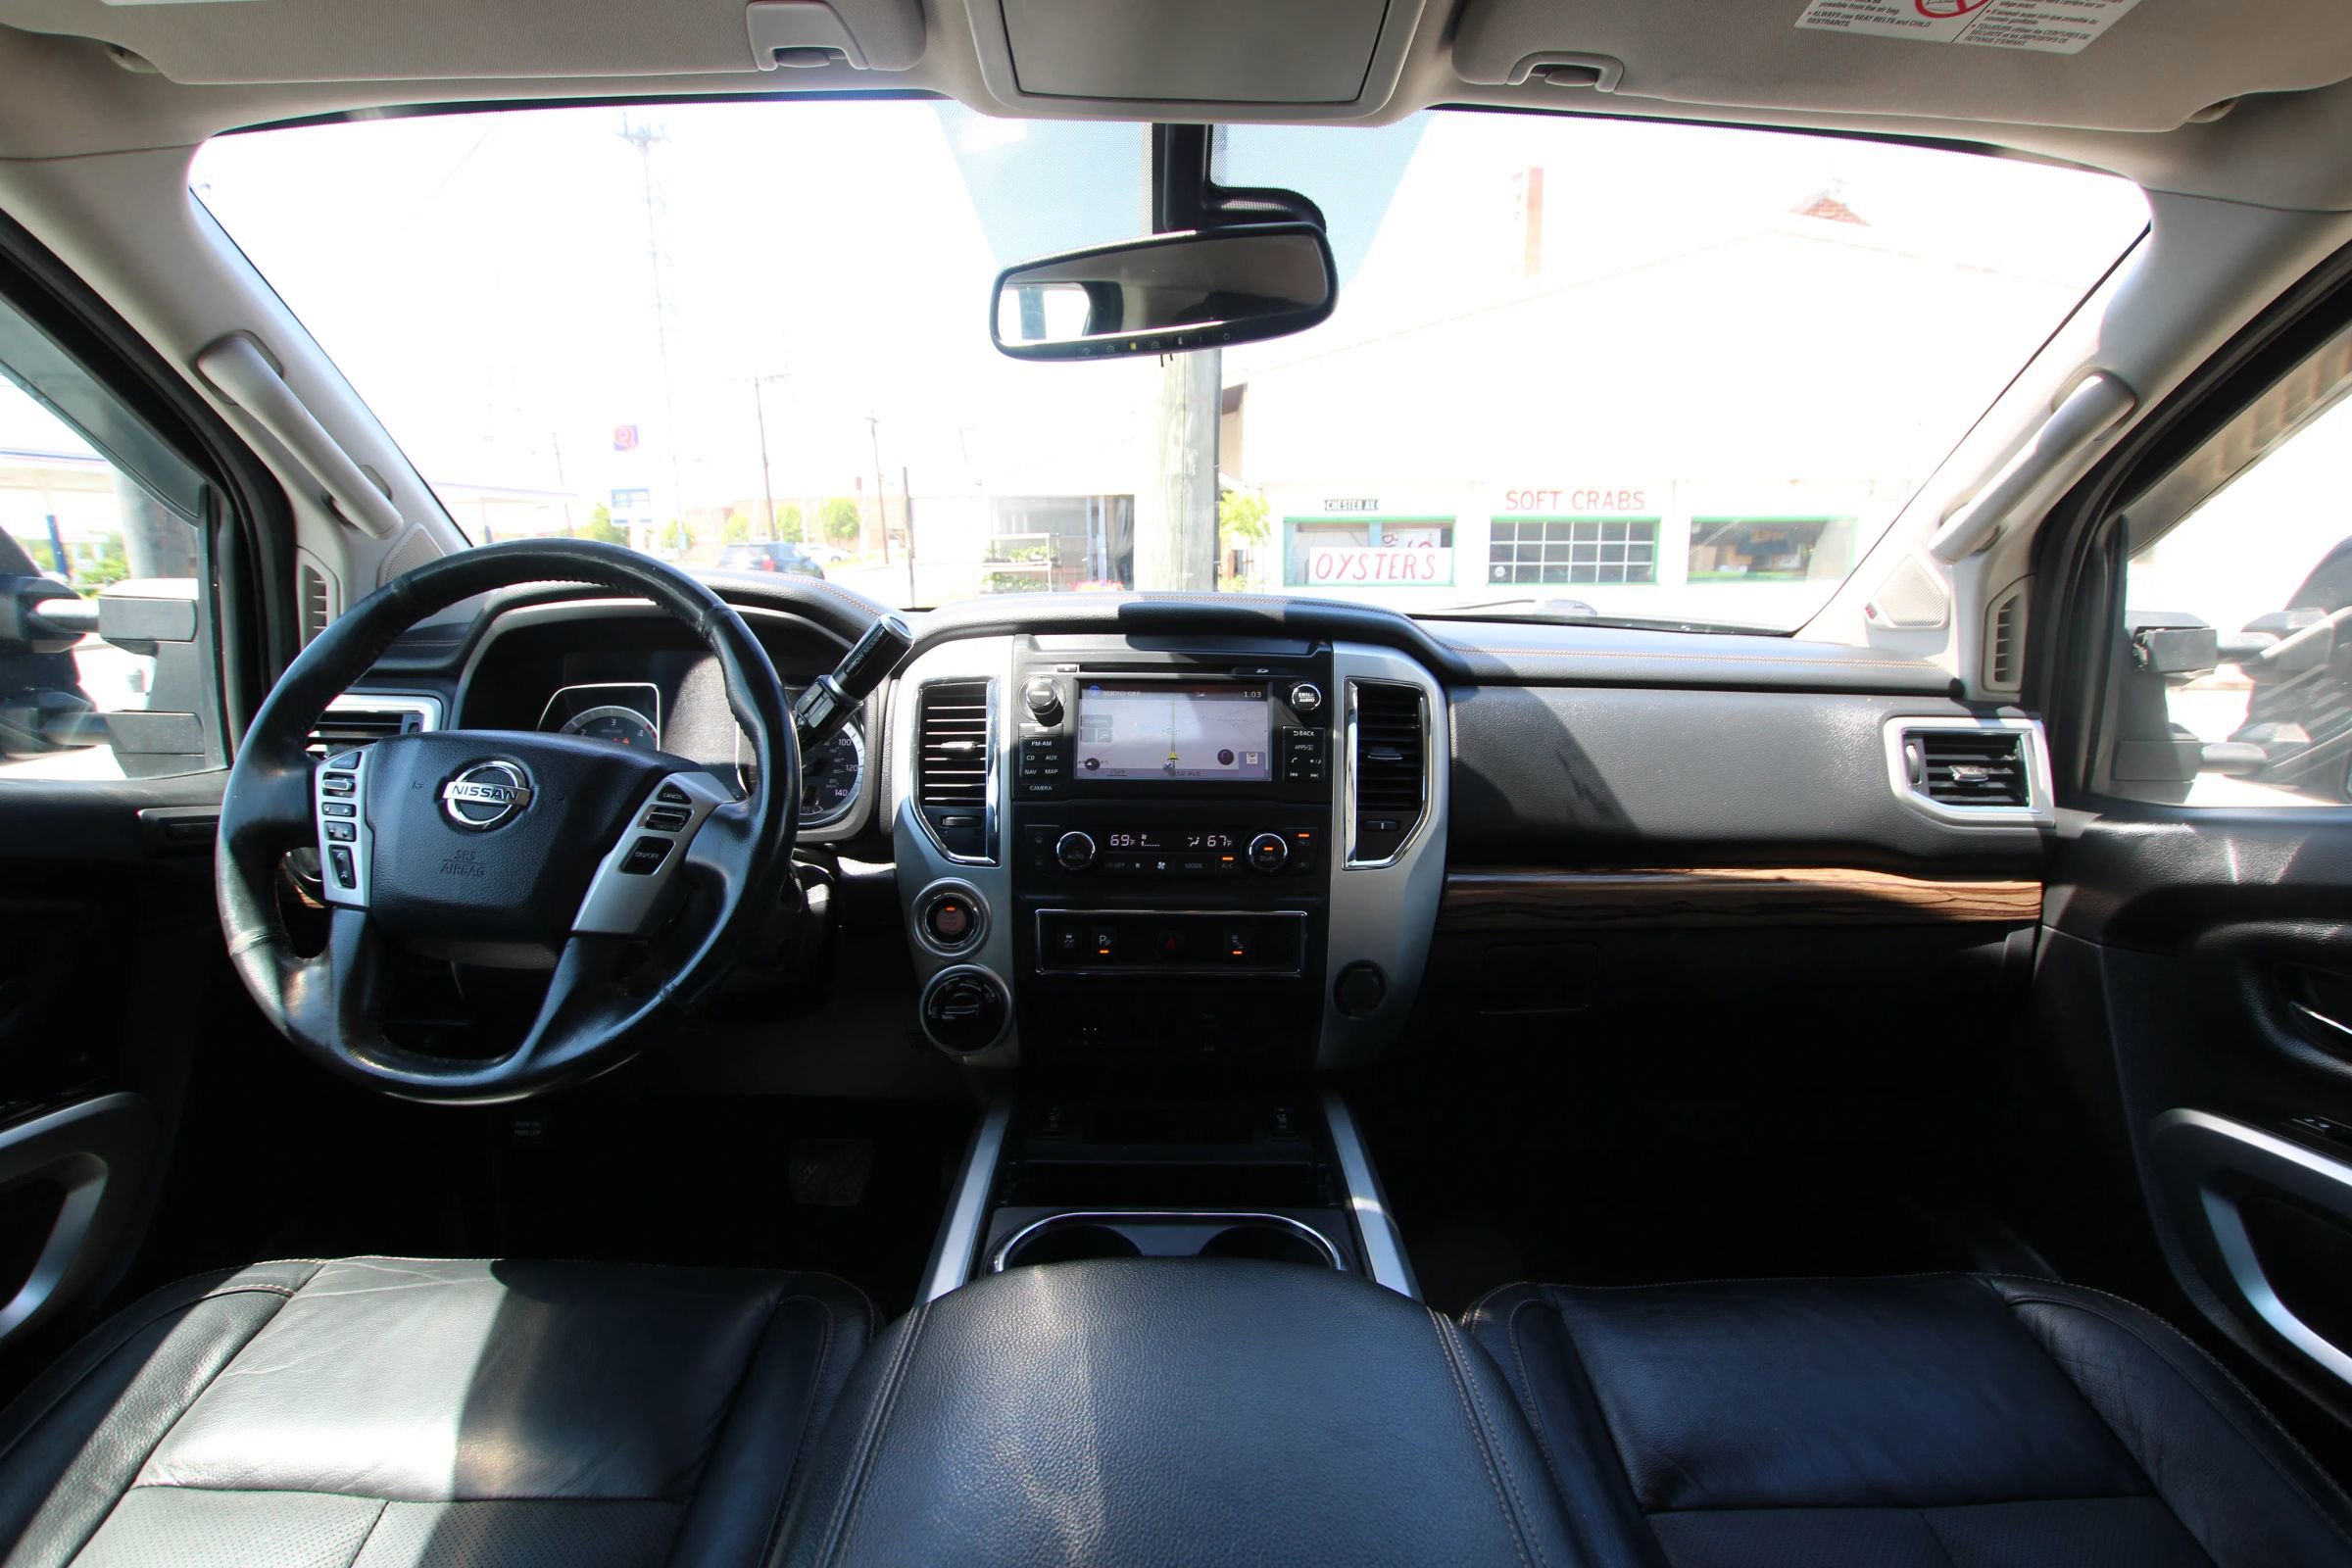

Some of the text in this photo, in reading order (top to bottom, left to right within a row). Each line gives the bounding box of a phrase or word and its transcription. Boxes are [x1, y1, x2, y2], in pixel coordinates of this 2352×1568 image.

[1505, 490, 1644, 511] SOFT CRABS
[1315, 553, 1436, 580] OYSTERS
[452, 785, 518, 801] NISSAN
[455, 849, 476, 861] SRS
[440, 863, 484, 877] AIRBAG
